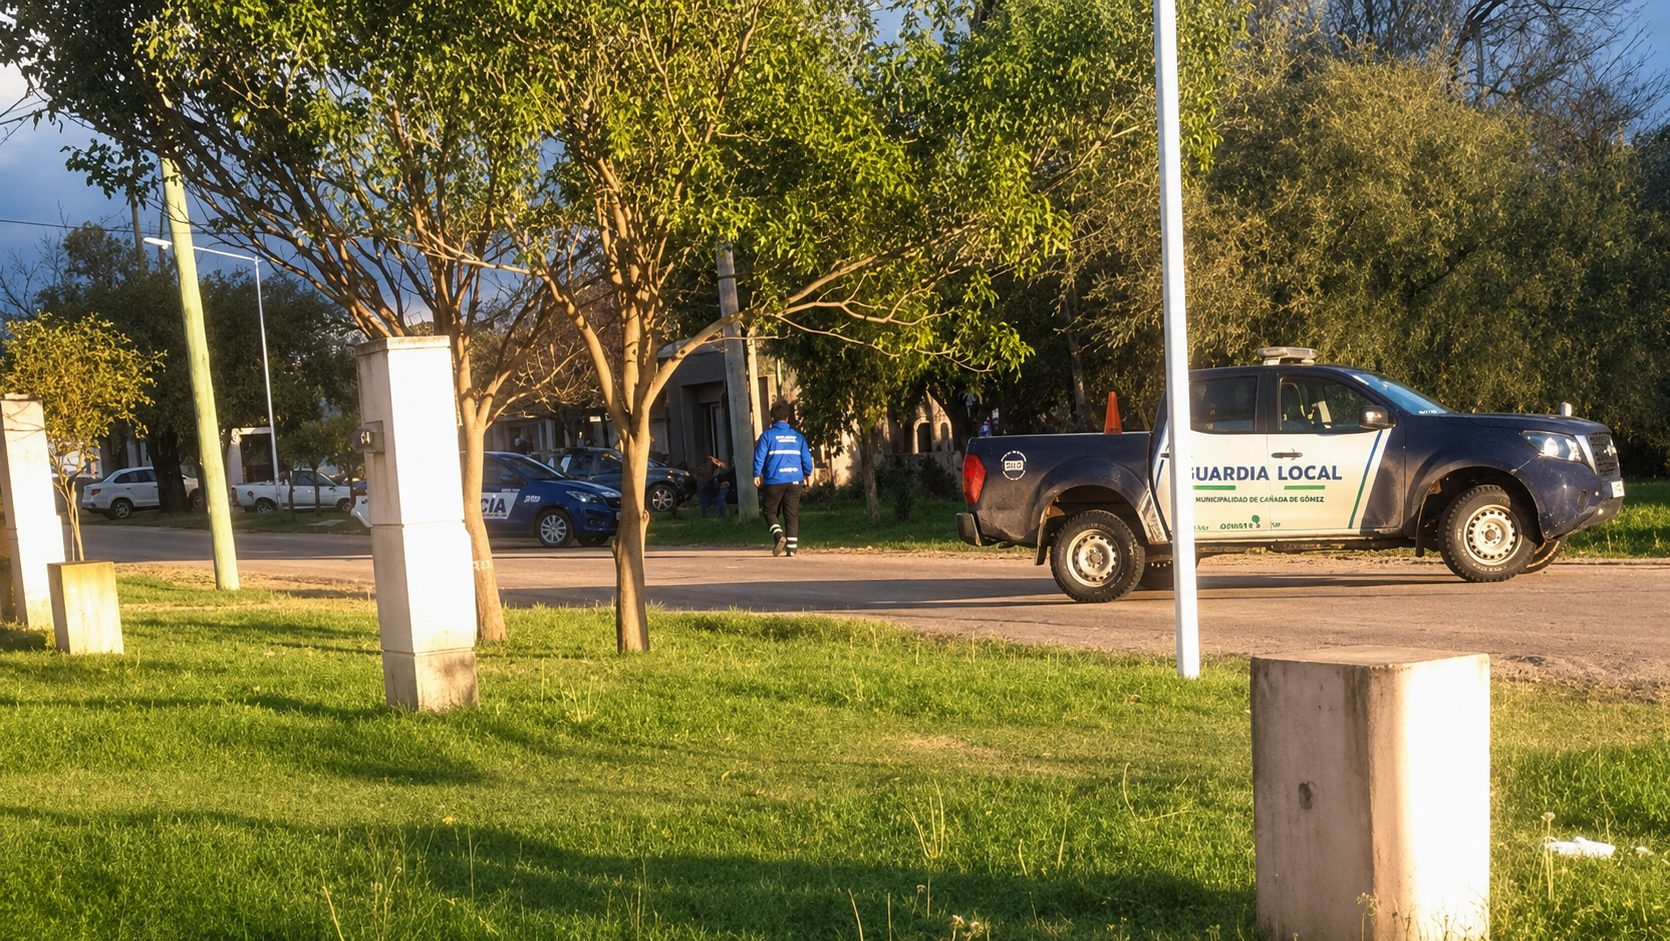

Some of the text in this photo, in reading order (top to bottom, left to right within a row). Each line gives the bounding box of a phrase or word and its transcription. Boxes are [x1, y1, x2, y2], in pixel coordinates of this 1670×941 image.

[1191, 465, 1343, 481] UARDIA LOCAL
[1259, 494, 1288, 503] CAÑADA
[1299, 494, 1325, 503] GÓMEZ
